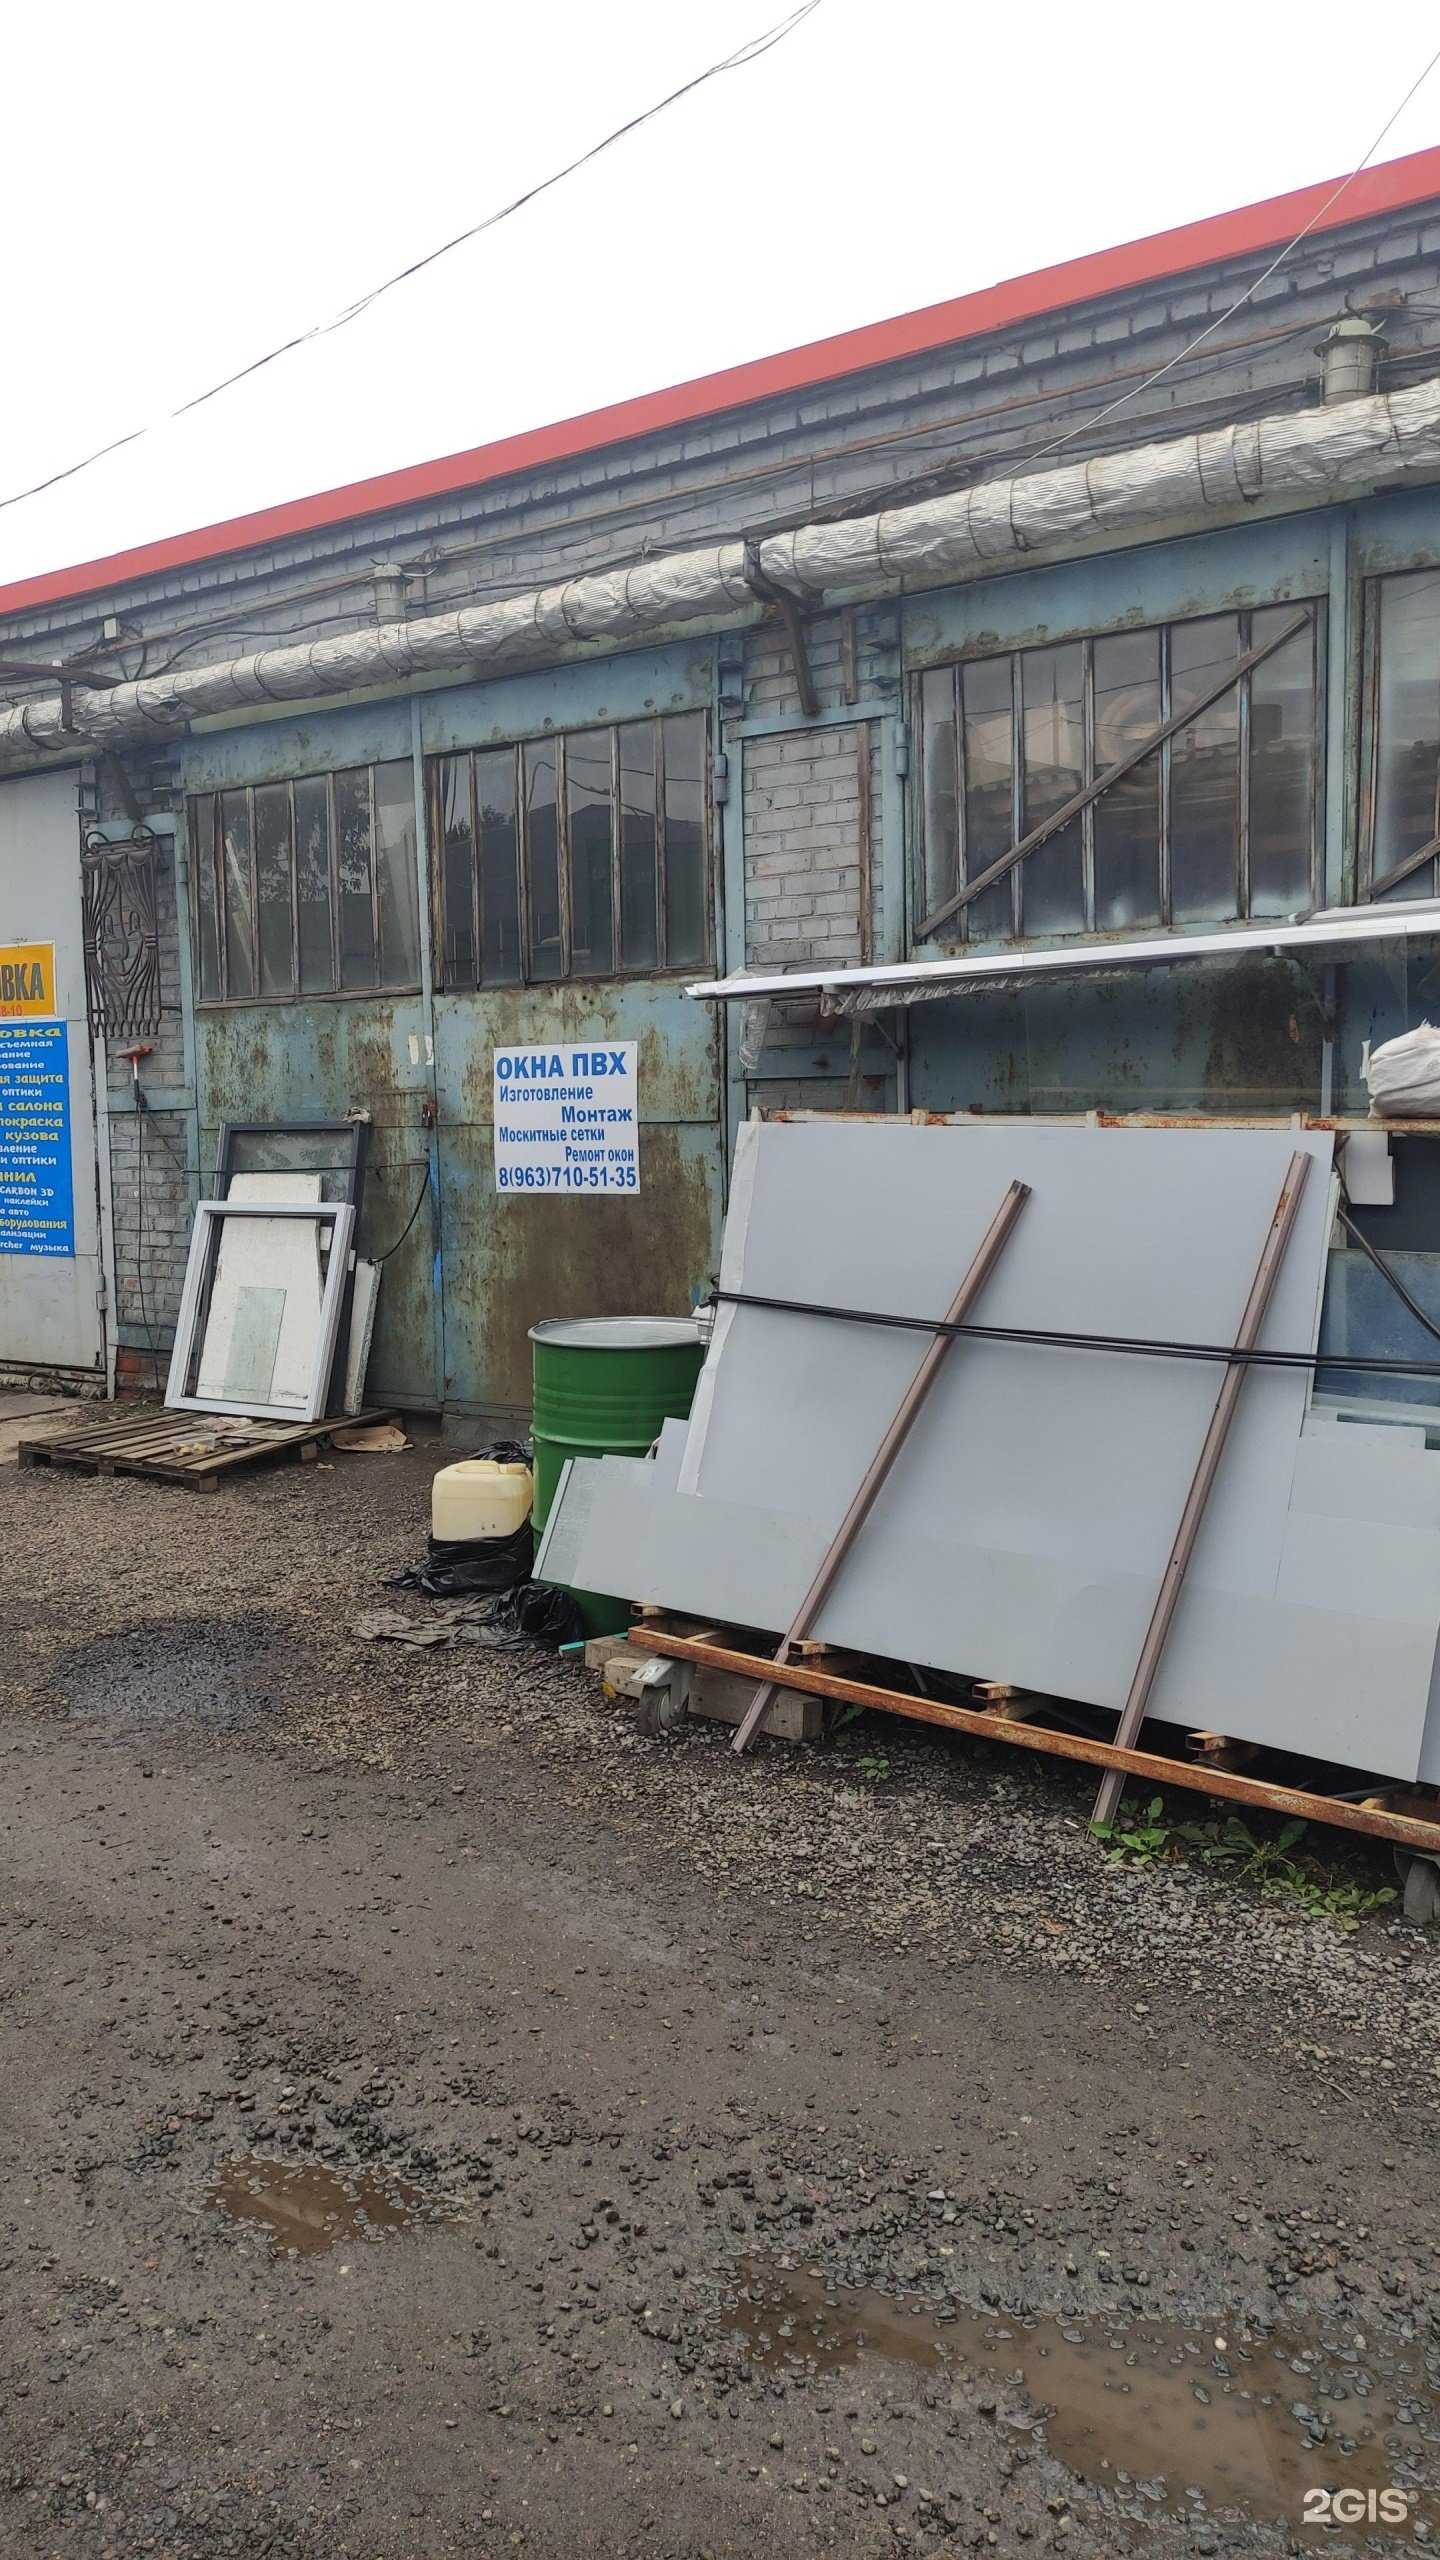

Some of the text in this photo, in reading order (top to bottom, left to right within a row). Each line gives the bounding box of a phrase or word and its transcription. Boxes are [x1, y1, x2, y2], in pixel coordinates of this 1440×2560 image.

[0, 962, 45, 1001] ВКА
[0, 1004, 23, 1017] 8-10
[0, 1051, 31, 1059] ание
[0, 1062, 45, 1070] ование
[496, 1051, 627, 1080] ОКНА ПВХ
[15, 1074, 64, 1086] защита
[2, 1088, 42, 1097] оптики
[500, 1085, 593, 1102] Изготовление
[8, 1102, 63, 1111] салона
[561, 1106, 632, 1123] Монтаж
[5, 1131, 59, 1143] кузова
[499, 1126, 605, 1142] Москитные сетки
[565, 1146, 634, 1162] Ремонт окон
[12, 1156, 57, 1165] оптики
[499, 1166, 637, 1187] 8(963)710-51-35
[40, 1188, 55, 1197] 3D
[30, 1243, 69, 1253] музыка
